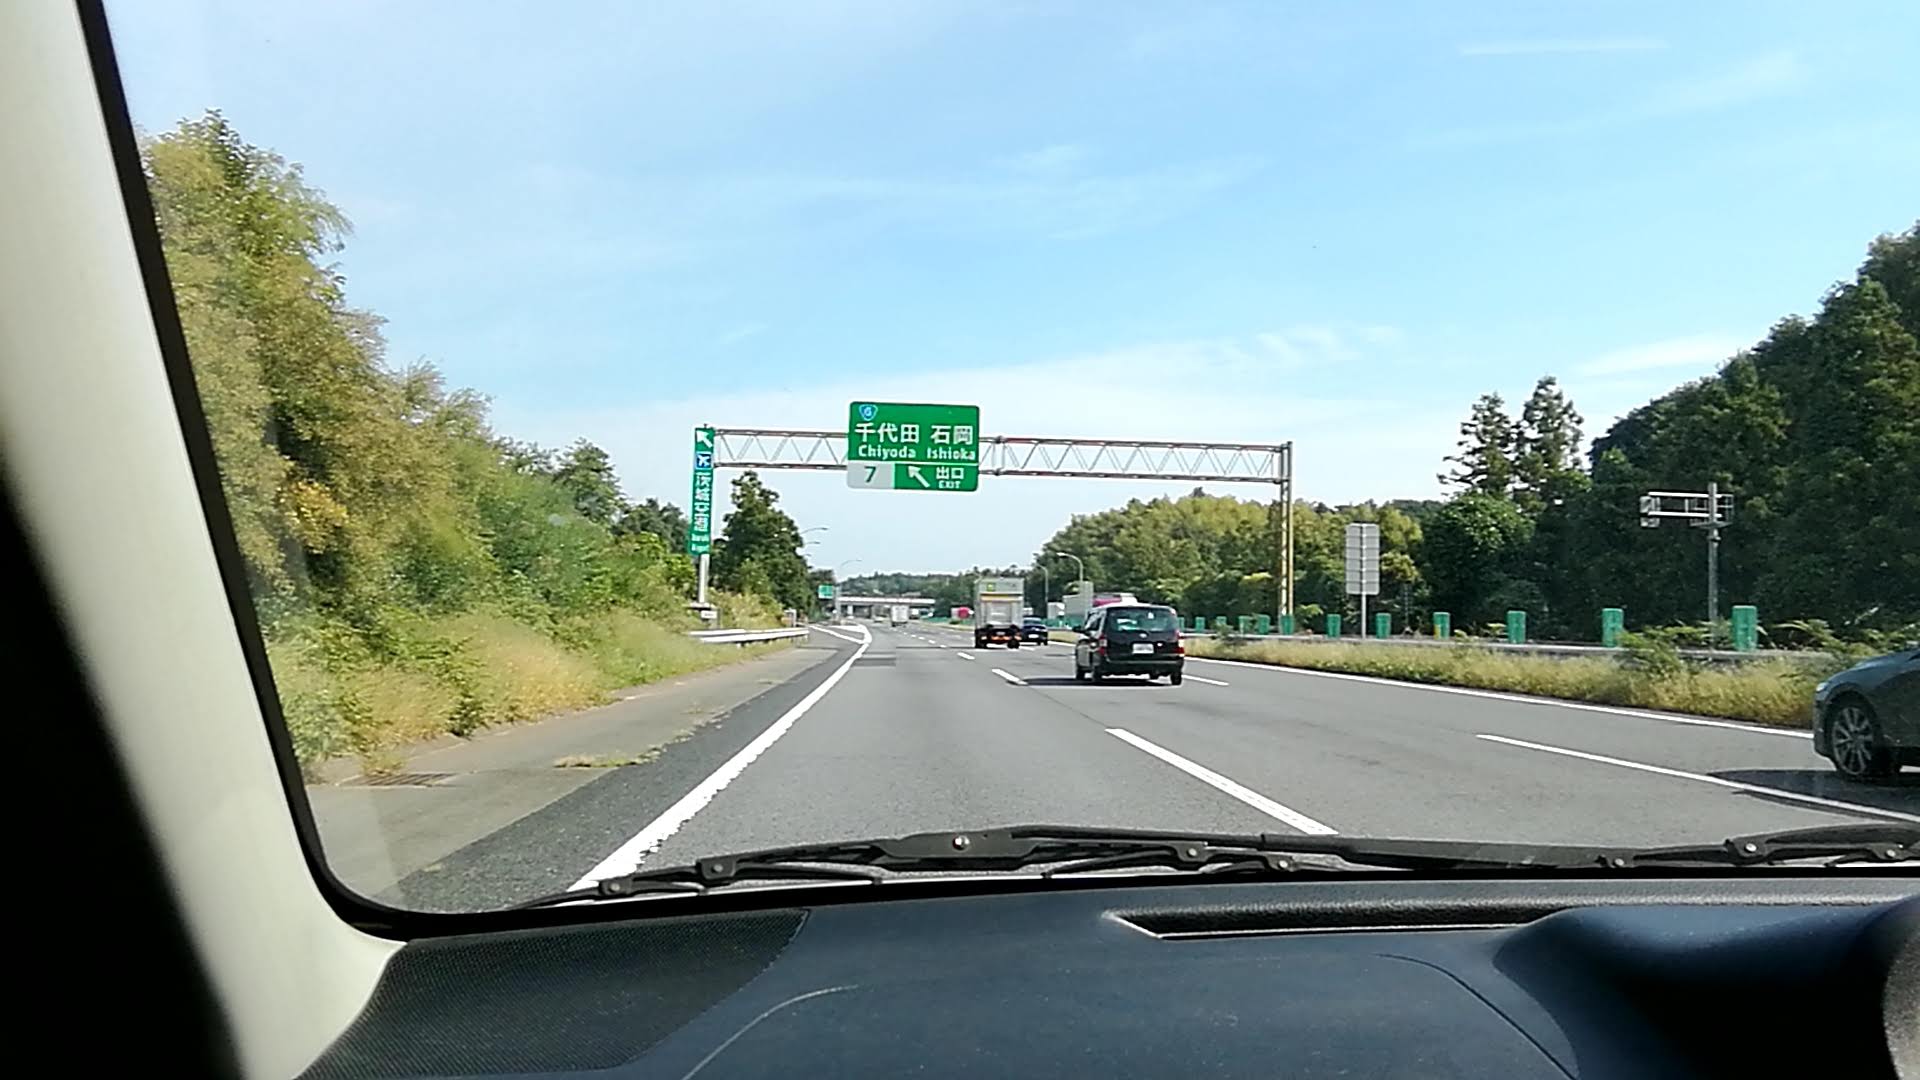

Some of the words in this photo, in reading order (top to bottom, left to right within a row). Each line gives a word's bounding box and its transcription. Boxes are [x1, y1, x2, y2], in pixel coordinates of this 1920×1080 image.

[864, 406, 872, 417] 6
[855, 422, 919, 443] 千代田
[930, 425, 974, 445] 石岡
[858, 444, 917, 460] Chiyoda
[927, 447, 976, 460] Ishioka
[864, 466, 877, 483] 7
[936, 466, 965, 480] 出口
[938, 480, 961, 489] EXIT
